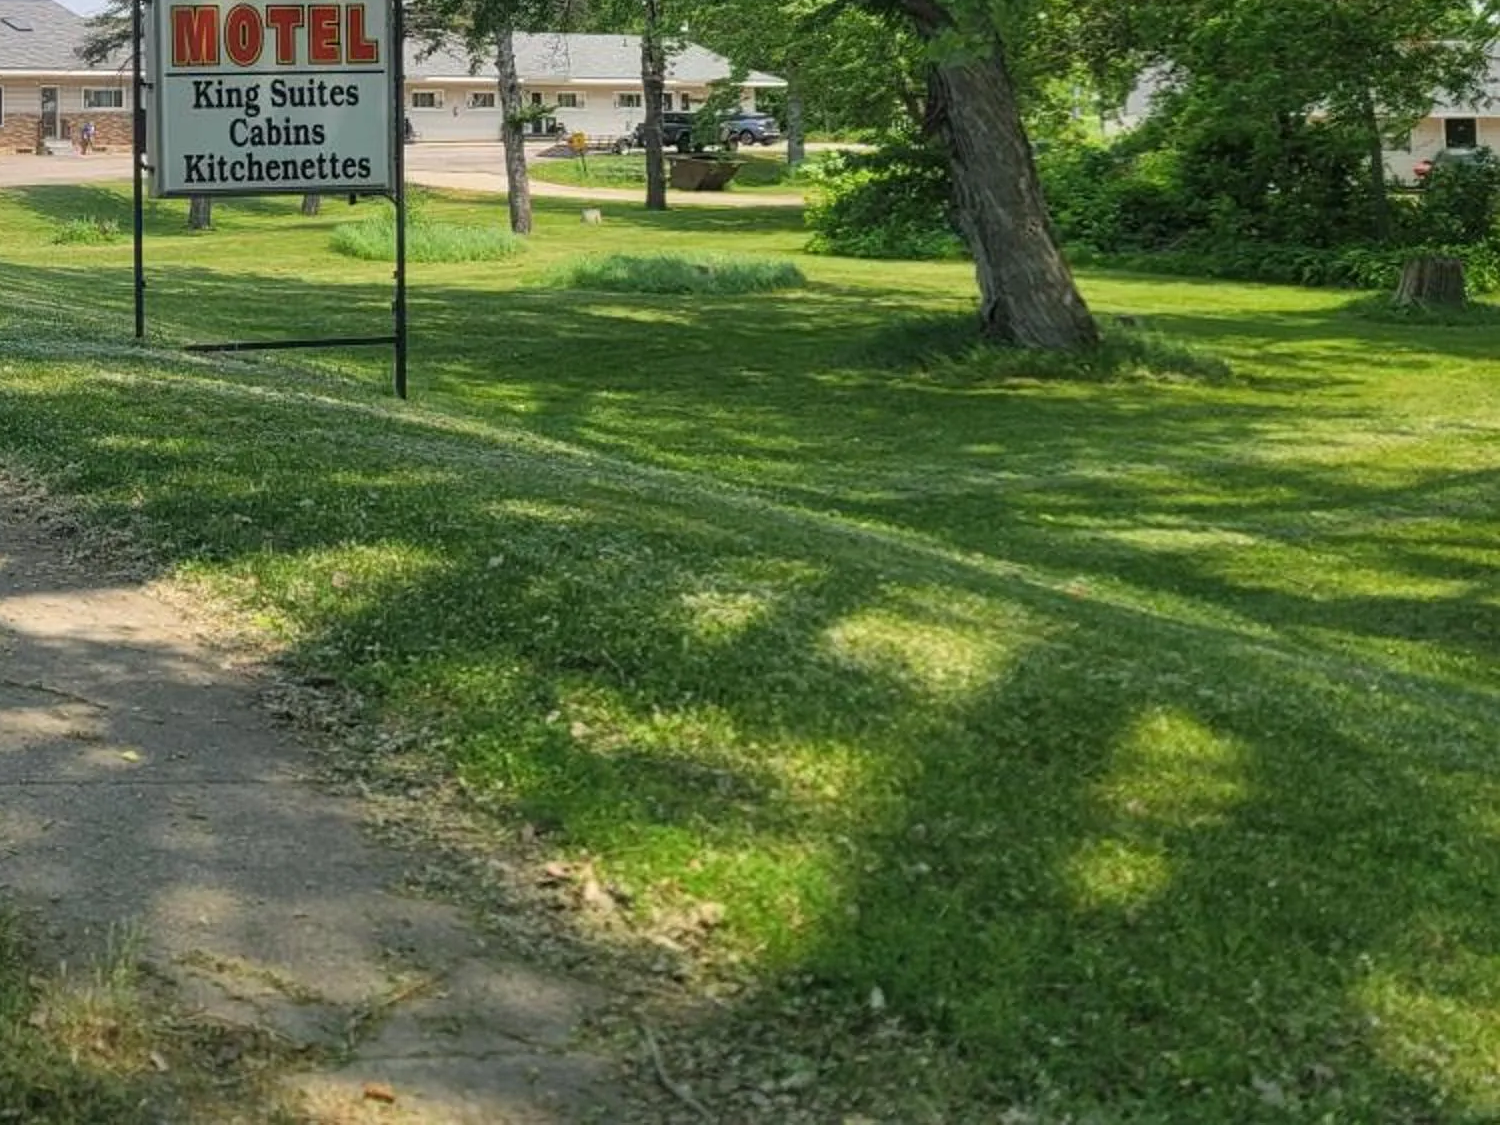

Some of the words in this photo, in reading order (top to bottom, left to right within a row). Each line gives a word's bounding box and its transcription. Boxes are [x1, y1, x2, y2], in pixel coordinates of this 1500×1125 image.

[171, 3, 380, 67] MOTEL
[192, 79, 261, 117] King
[270, 78, 360, 108] Suites
[229, 117, 326, 148] Cabins
[183, 152, 372, 184] Kitchenettes
